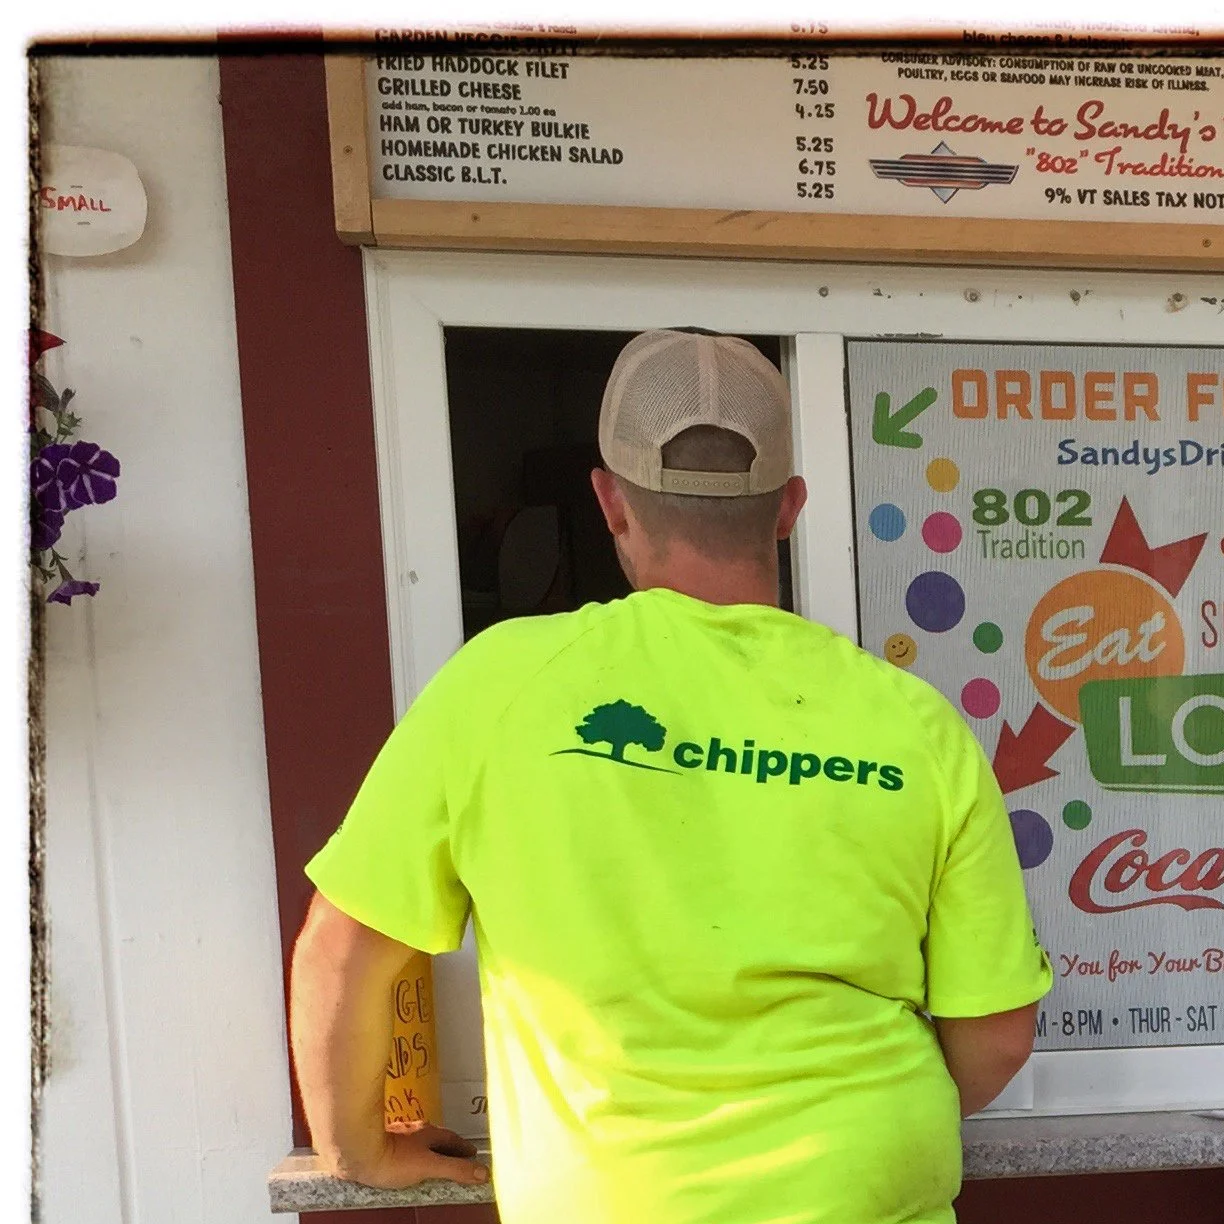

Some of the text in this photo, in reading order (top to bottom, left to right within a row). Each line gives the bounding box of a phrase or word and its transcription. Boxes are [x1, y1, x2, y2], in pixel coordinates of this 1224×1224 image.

[432, 57, 569, 79] HADDOCK FILET
[378, 77, 521, 100] GRILLED CHEESE
[793, 79, 828, 95] 7.50
[796, 103, 835, 118] 4.25
[865, 92, 1024, 135] Welcome
[1030, 105, 1067, 137] to
[1074, 100, 1216, 153] Sandy's
[380, 115, 590, 140] HAM OR TURKEY BULKIE
[381, 140, 623, 164] HOMEMADE CHICKEN SALAD
[796, 137, 833, 152] 5.25
[799, 158, 835, 175] 6.75
[1026, 148, 1088, 174] "802"
[383, 164, 507, 184] CLASSIC B.L.T.
[40, 187, 111, 212] SMALL
[797, 182, 834, 199] 5.25
[1045, 188, 1071, 204] 9%
[1077, 189, 1097, 205] VT
[1103, 189, 1149, 206] SALES
[1156, 192, 1188, 208] TAX
[952, 368, 1160, 422] ORDER
[972, 488, 1092, 526] 802
[976, 530, 1085, 559] Tradition
[1037, 605, 1167, 681] Eat
[673, 737, 904, 791] chippers
[1060, 954, 1104, 978] You
[1108, 950, 1141, 982] for
[1148, 951, 1201, 974] Your
[1062, 1009, 1102, 1035] 8 PM
[1129, 1007, 1171, 1033] THUR
[1187, 1005, 1217, 1031] SAT
